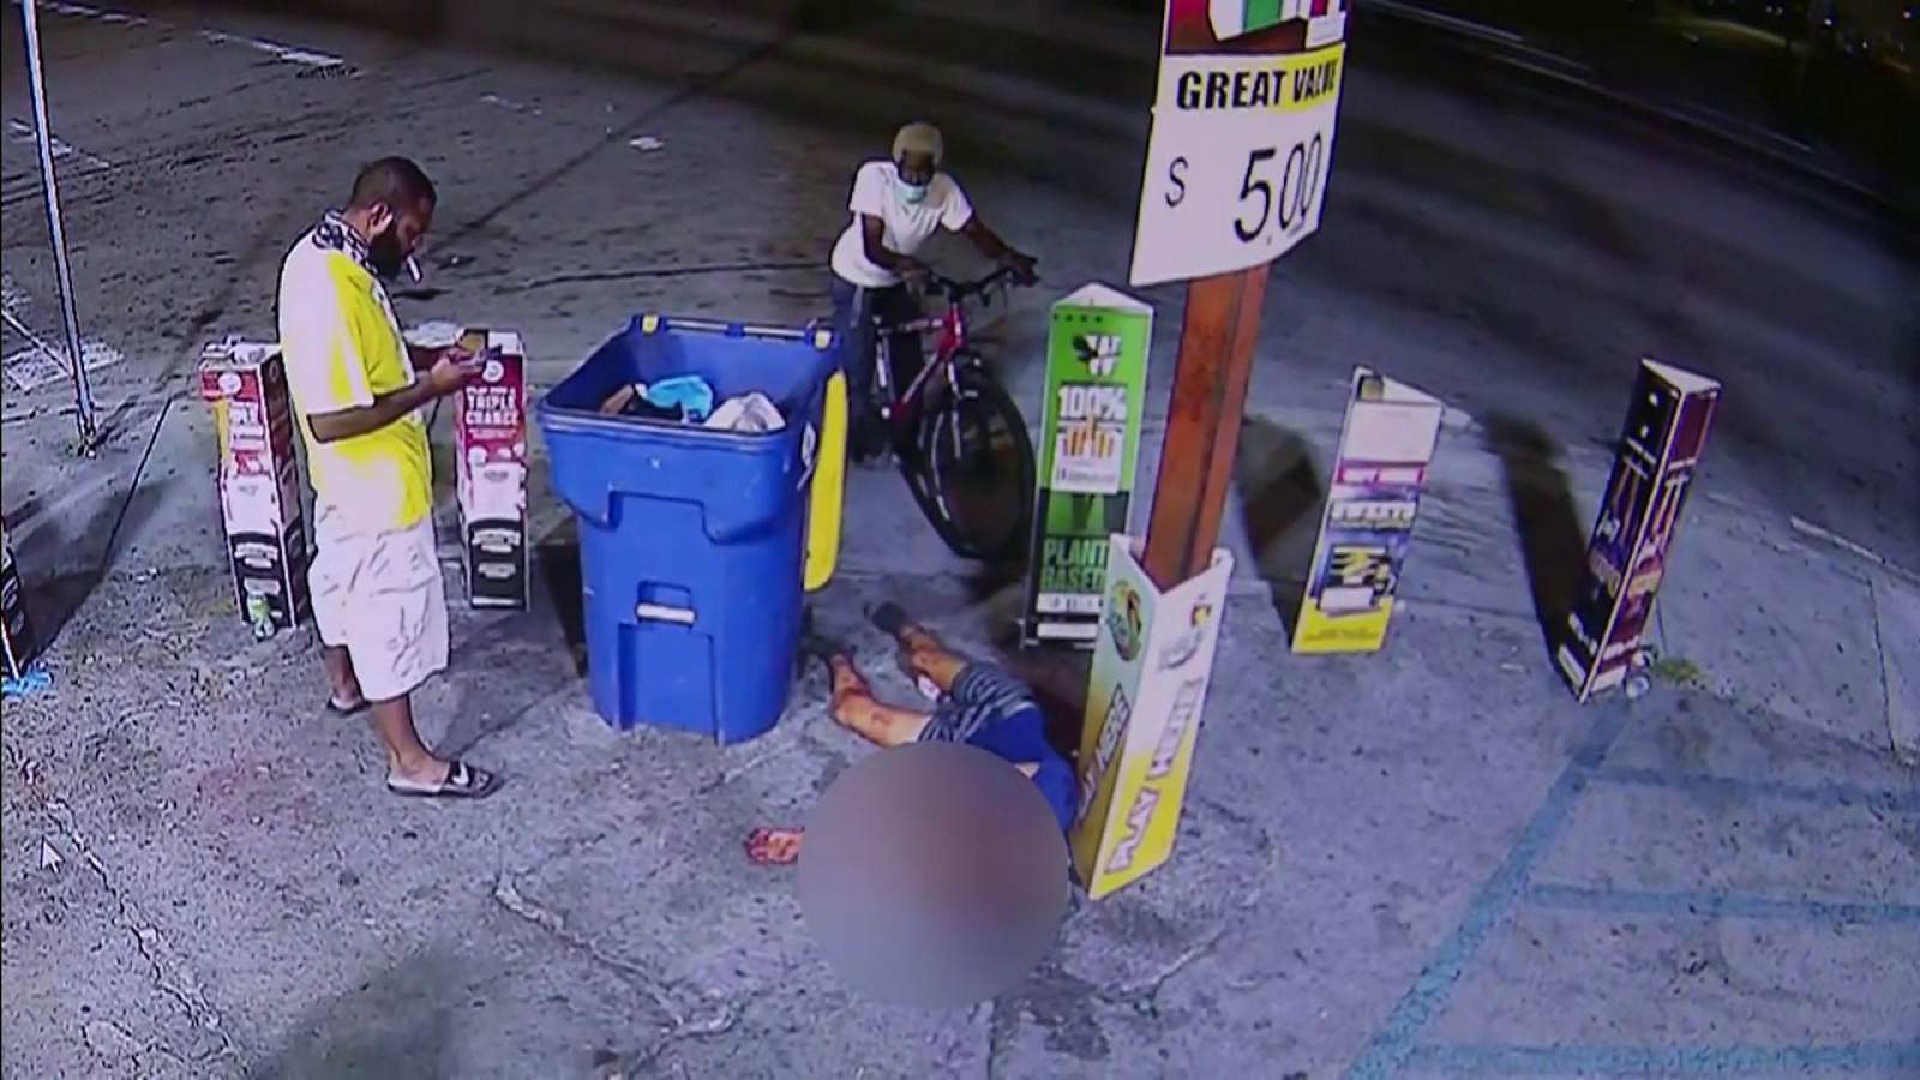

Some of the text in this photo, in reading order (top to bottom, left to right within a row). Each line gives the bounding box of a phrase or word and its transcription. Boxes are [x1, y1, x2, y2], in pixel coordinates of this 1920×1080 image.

[1176, 59, 1338, 110] GREAT VALUE
[1233, 131, 1322, 245] 5.00
[1057, 385, 1128, 421] 100%
[1043, 539, 1109, 567] PLANT
